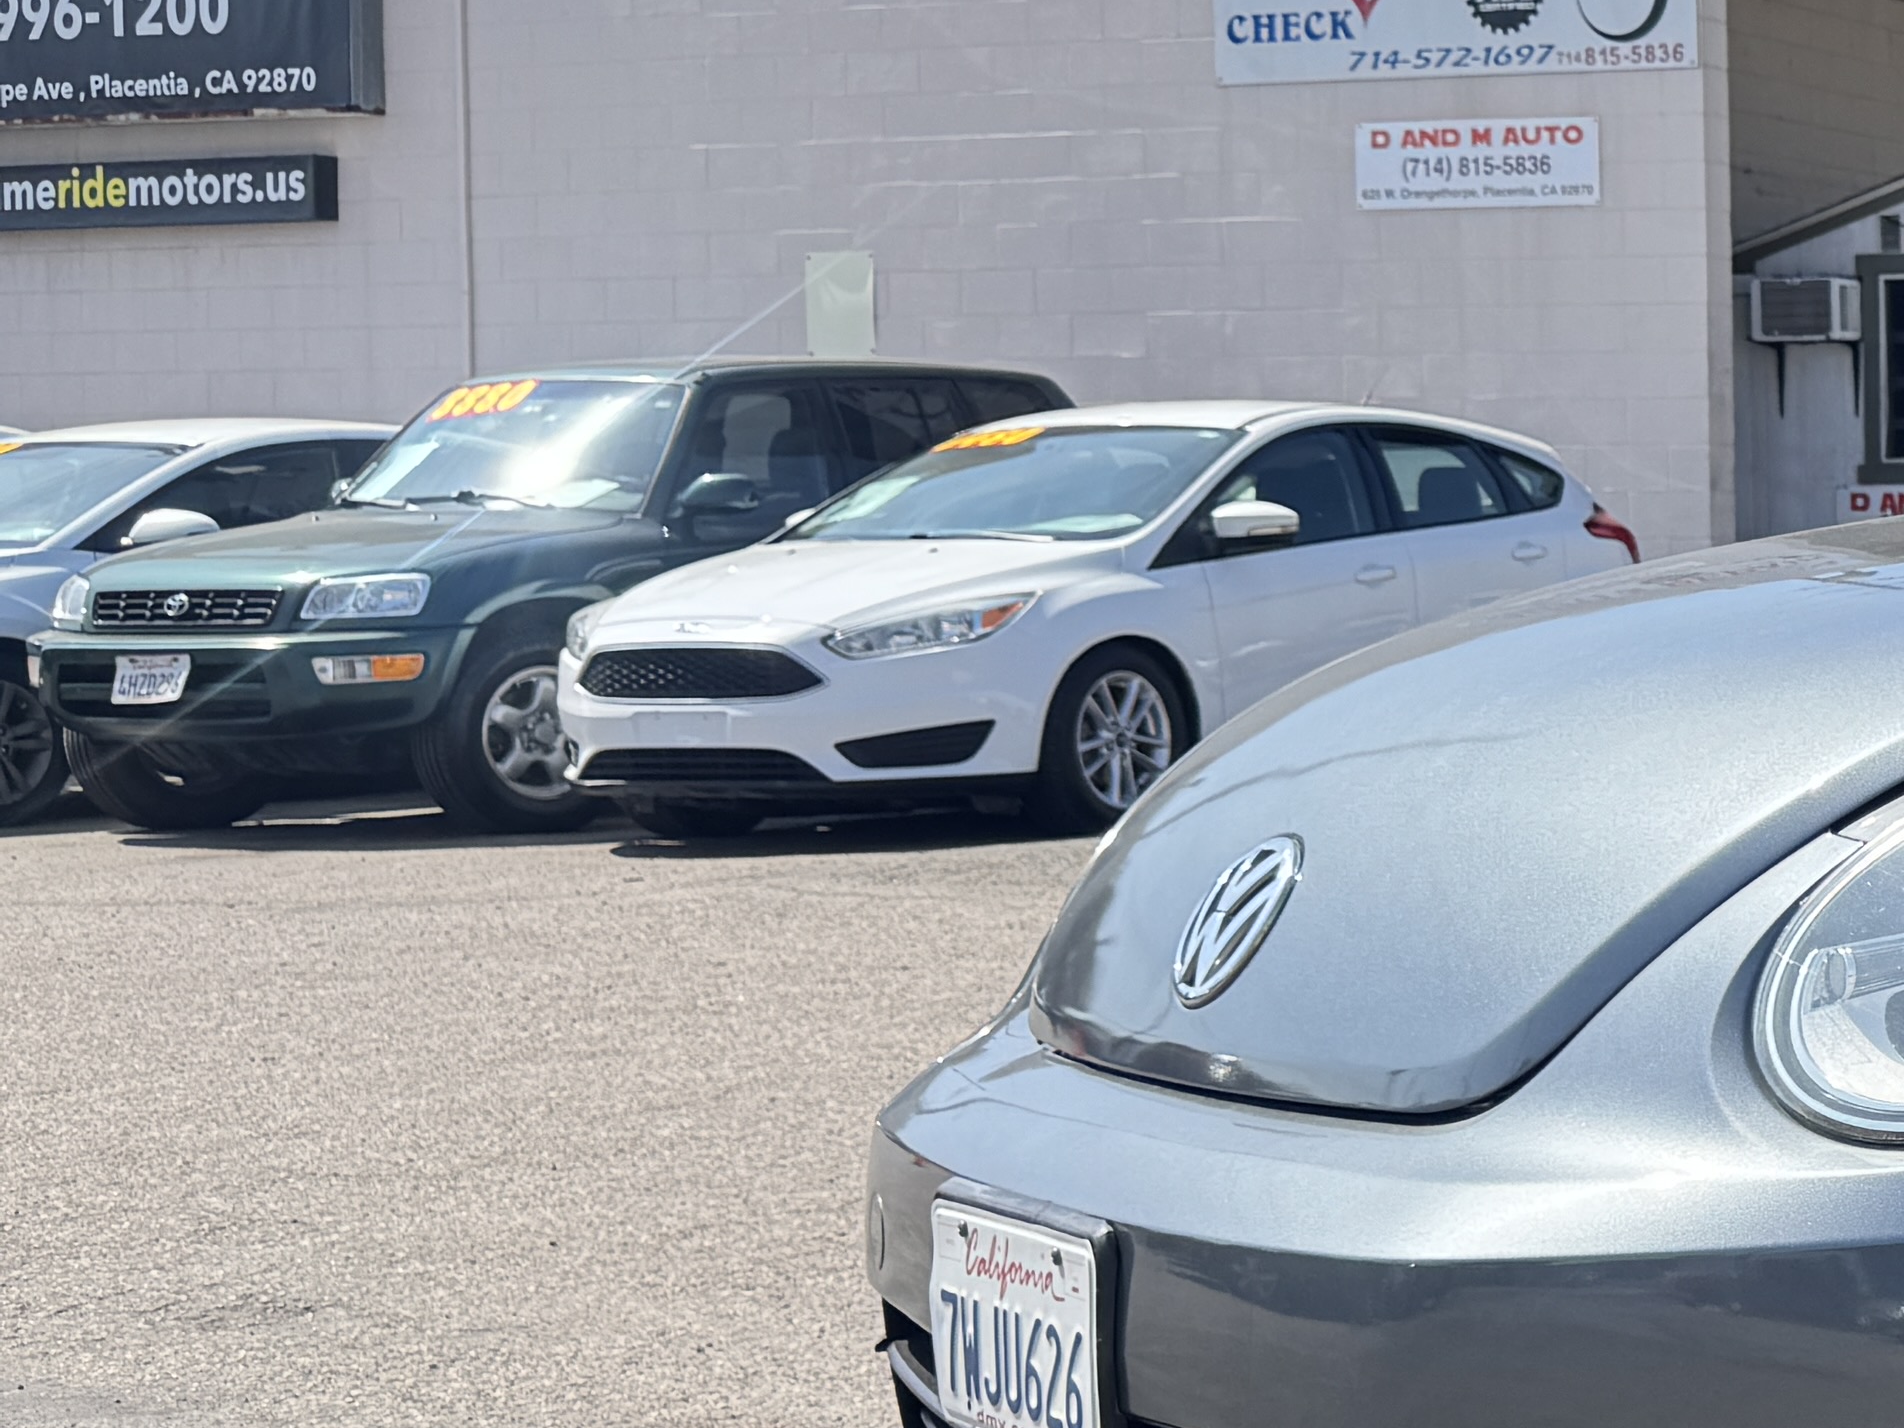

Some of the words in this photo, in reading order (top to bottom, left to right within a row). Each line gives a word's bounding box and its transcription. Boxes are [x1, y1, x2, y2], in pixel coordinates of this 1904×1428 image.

[1227, 10, 1356, 45] CHECK
[1349, 45, 1556, 72] 714-572-1697
[33, 77, 74, 100] Ave
[90, 72, 189, 99] Placentia
[205, 70, 239, 95] CA
[242, 67, 317, 93] 92870
[1371, 130, 1391, 149] D
[1401, 128, 1461, 149] AND
[1471, 127, 1492, 147] M
[1502, 125, 1584, 147] AUTO
[1402, 155, 1451, 183] (714)
[1458, 154, 1552, 177] 815-5836
[1850, 492, 1870, 512] D
[965, 1227, 1066, 1302] California
